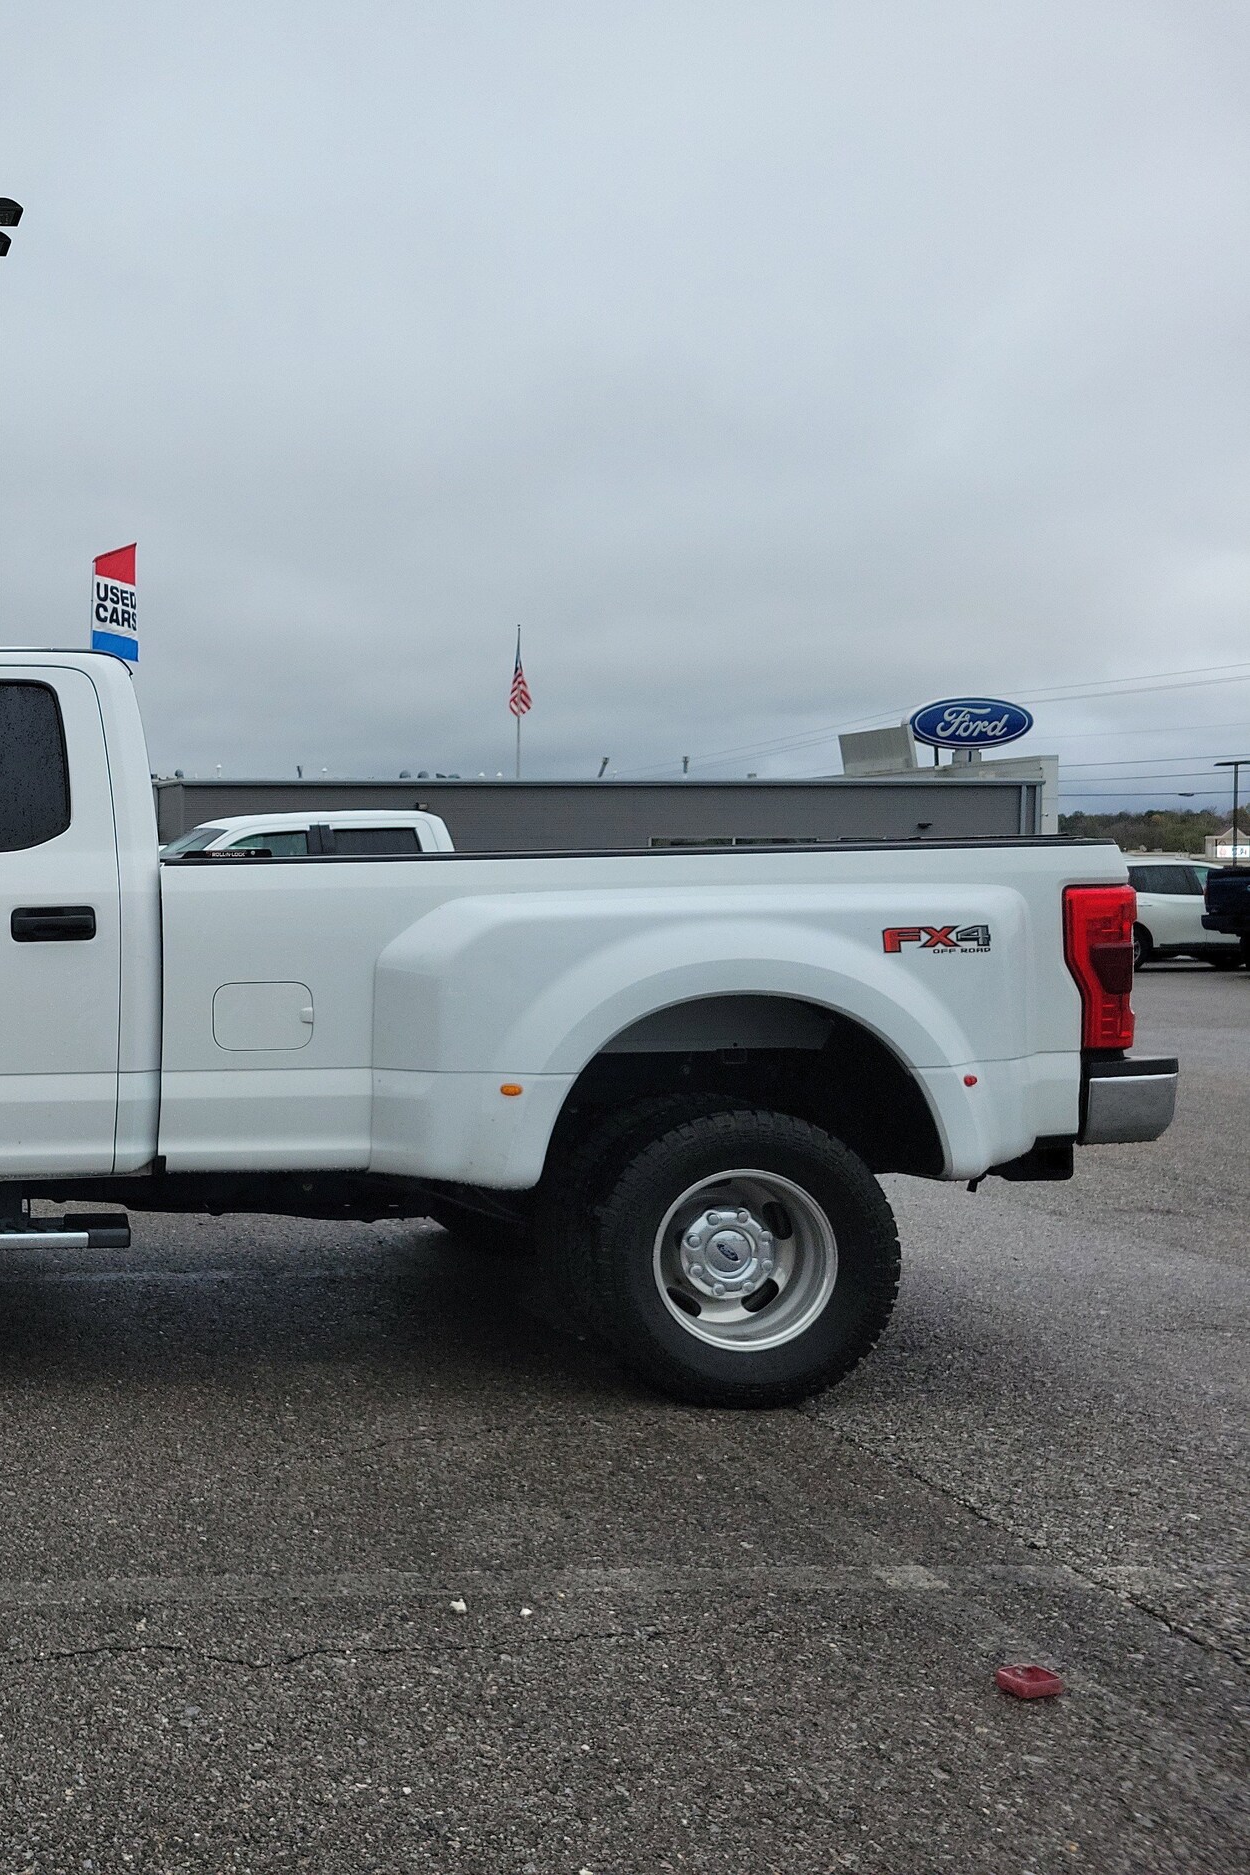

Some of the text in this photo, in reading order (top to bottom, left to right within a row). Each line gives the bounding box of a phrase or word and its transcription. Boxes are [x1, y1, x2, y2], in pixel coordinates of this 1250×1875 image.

[96, 582, 137, 610] USED
[95, 603, 137, 631] CARS
[936, 706, 1010, 737] Ford
[882, 925, 991, 953] FX4
